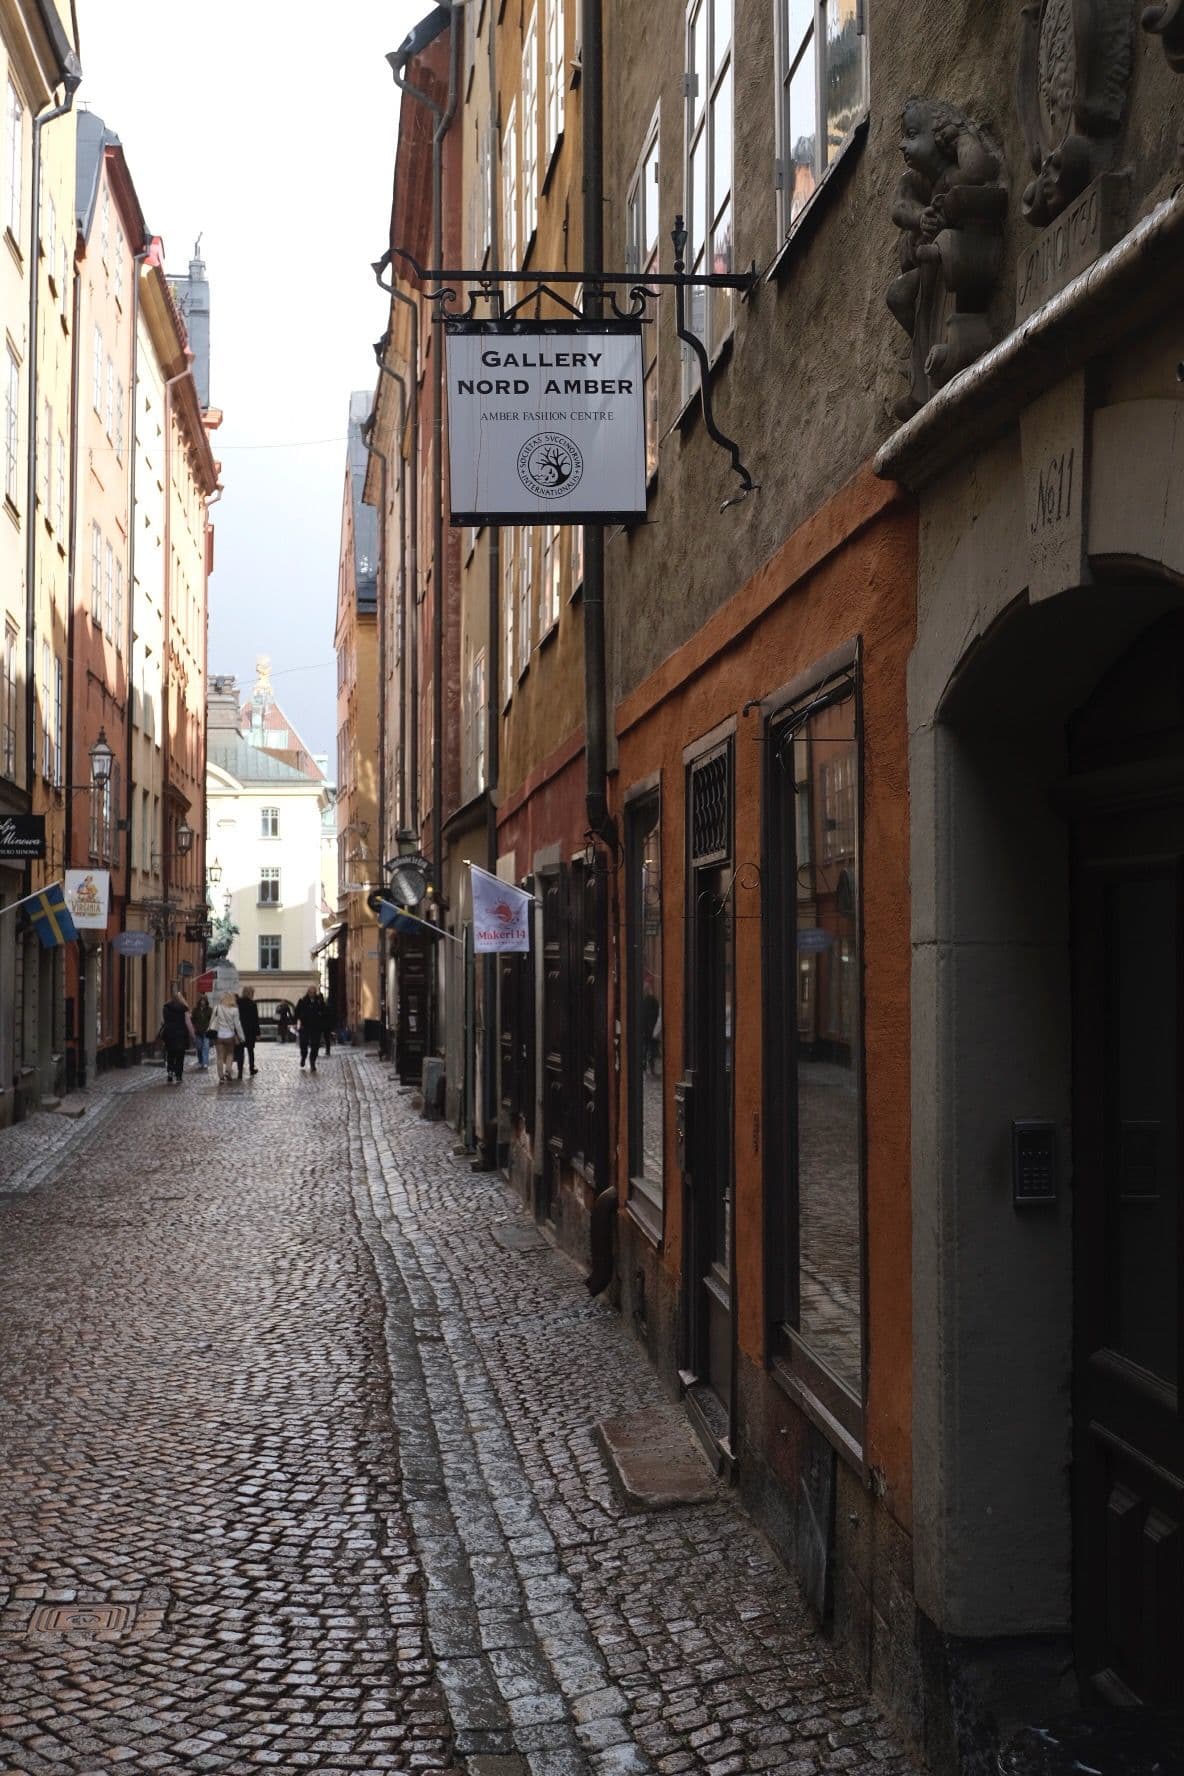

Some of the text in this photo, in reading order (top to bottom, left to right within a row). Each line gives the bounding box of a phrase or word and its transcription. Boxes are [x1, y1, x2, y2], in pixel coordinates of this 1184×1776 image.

[481, 350, 603, 368] GALLERY
[457, 379, 633, 395] NORD AMBER
[481, 411, 614, 421] AMBER FASHION CENTRE
[520, 436, 543, 468] SOCIETAS
[521, 474, 580, 496] INTERNATIONALIS
[477, 929, 514, 940] Makeri
